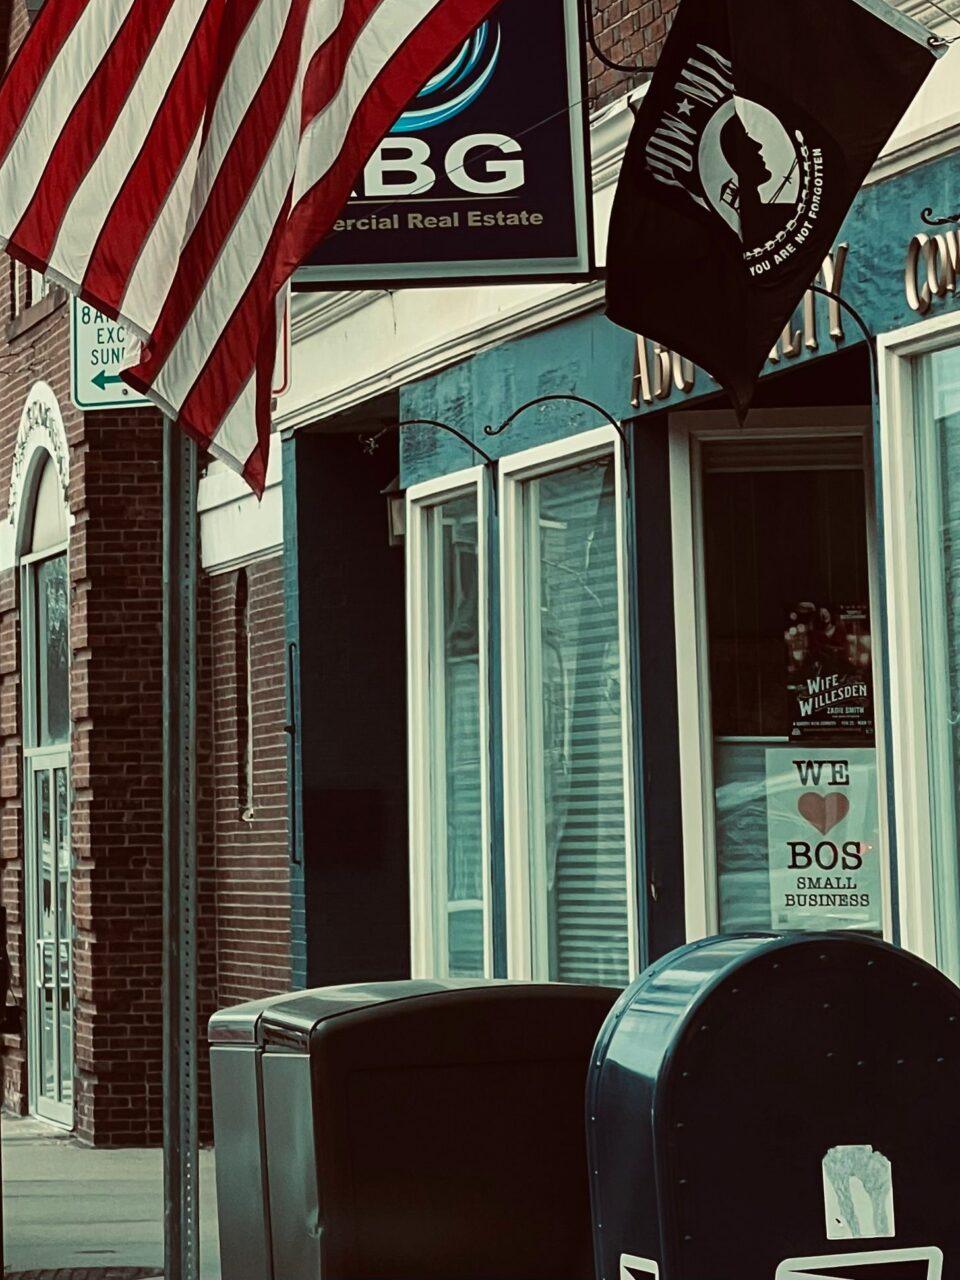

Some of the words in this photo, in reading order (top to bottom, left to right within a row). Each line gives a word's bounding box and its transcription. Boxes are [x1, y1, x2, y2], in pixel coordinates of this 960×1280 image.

[348, 132, 525, 198] BG
[408, 211, 459, 229] Real
[468, 209, 544, 228] Estate
[749, 260, 771, 277] YOU
[773, 243, 797, 265] ARE
[794, 220, 813, 244] NOT
[808, 148, 824, 219] FORGOTTEN
[792, 760, 850, 786] WE
[786, 841, 863, 871] BOS
[796, 876, 858, 890] SMALL
[784, 893, 870, 908] BUSINESS
